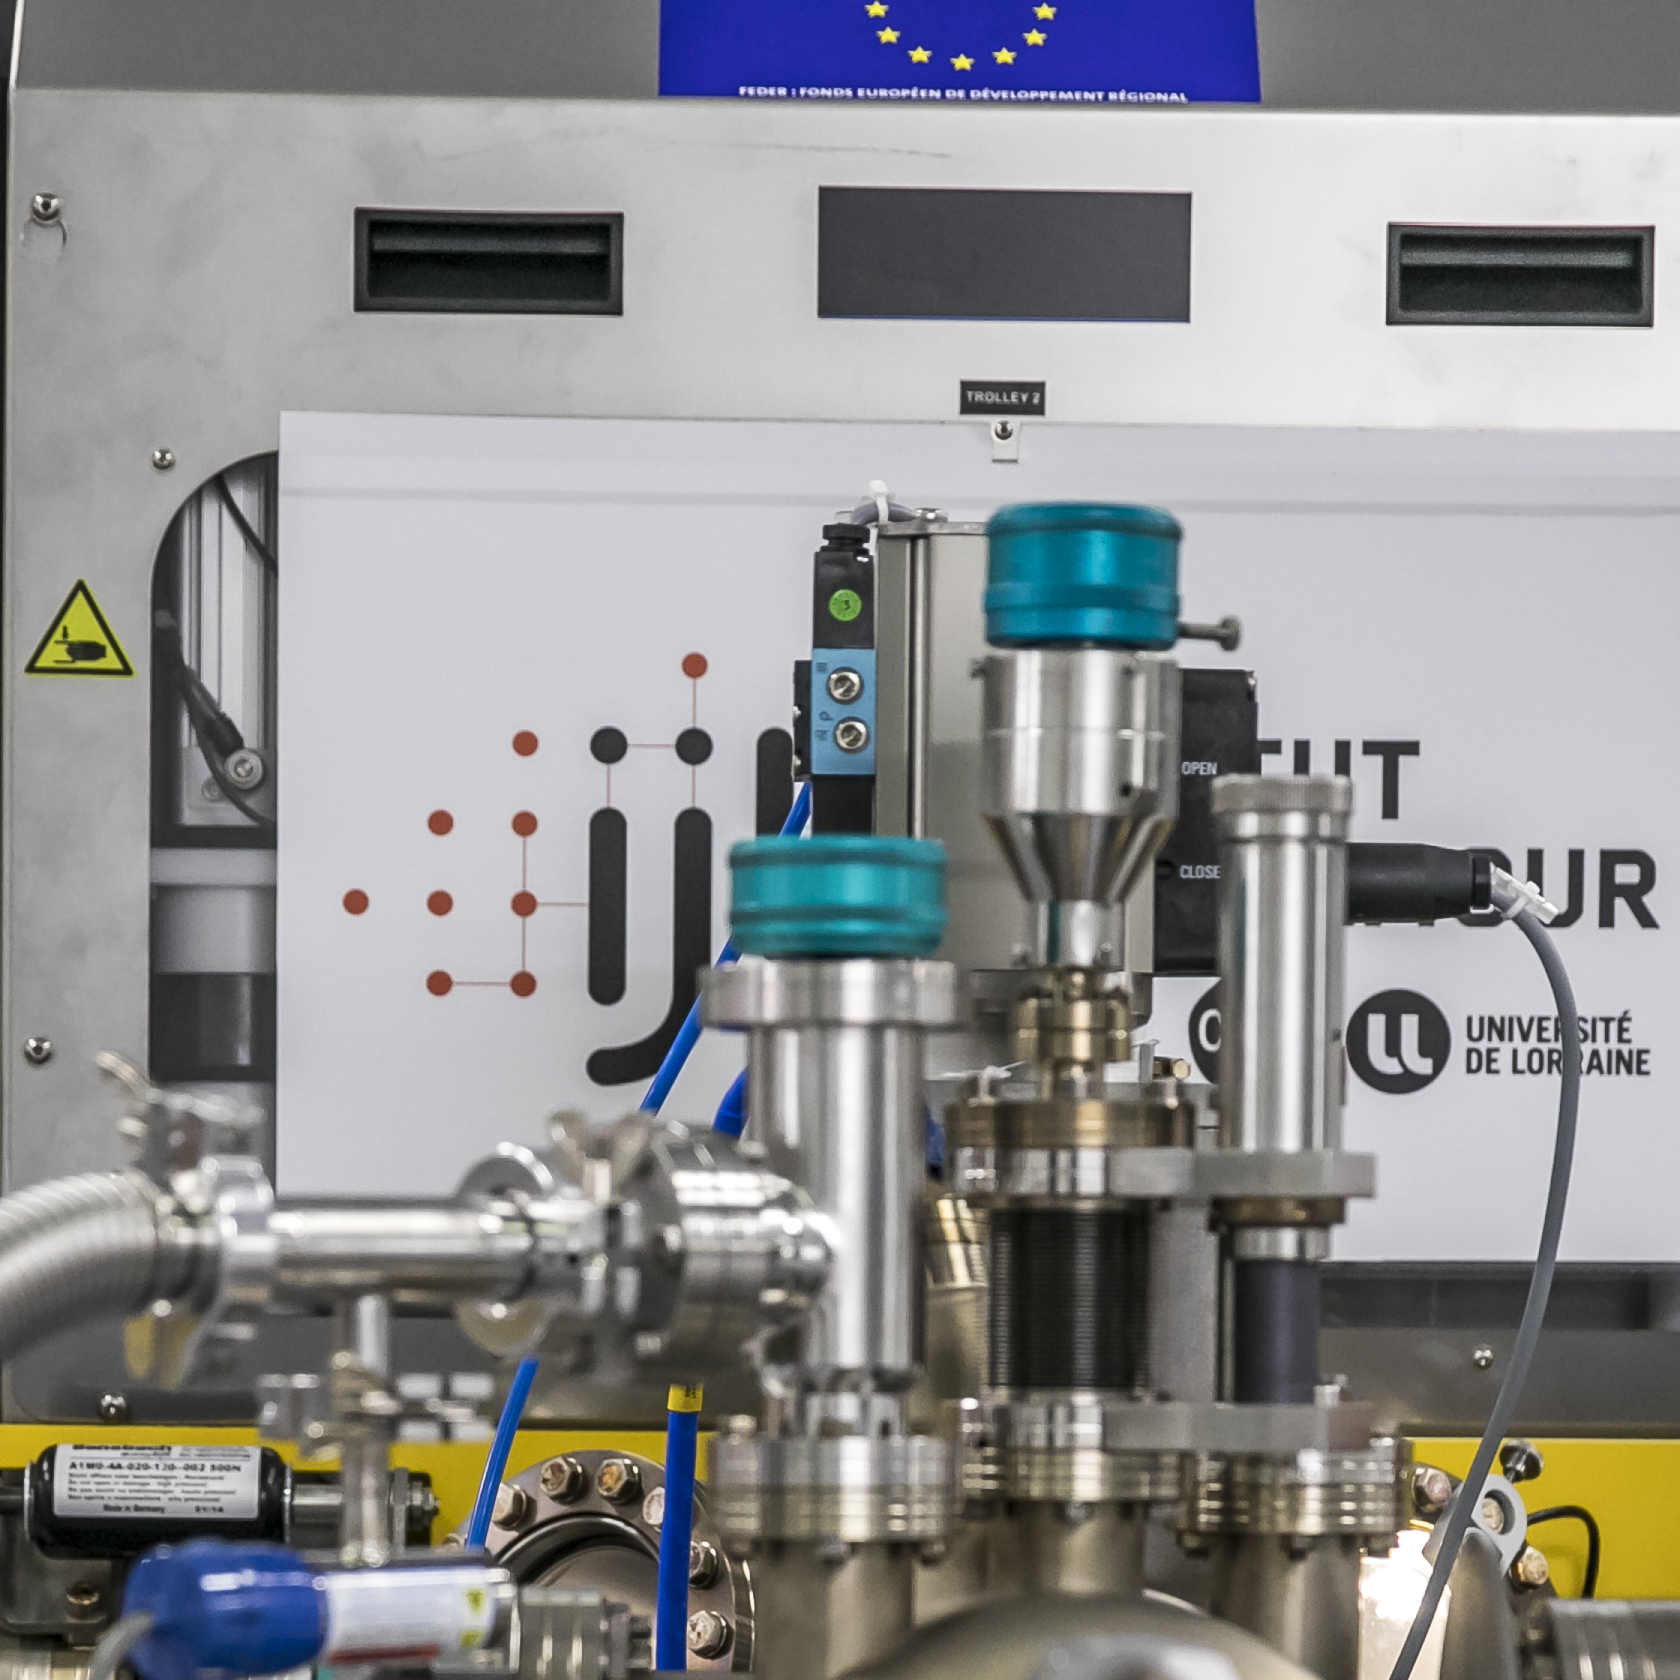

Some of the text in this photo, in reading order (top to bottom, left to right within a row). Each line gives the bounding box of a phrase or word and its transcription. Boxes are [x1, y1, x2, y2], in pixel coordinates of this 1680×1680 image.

[739, 86, 787, 97] FEDER
[799, 86, 853, 98] FONDS
[857, 85, 941, 100] EUROPÉEN
[945, 88, 965, 100] DE
[966, 390, 1029, 405] TROLLEY
[1181, 761, 1217, 775] OPEN
[1180, 865, 1221, 879] CLOSE
[1466, 1047, 1651, 1076] DE LORAINE
